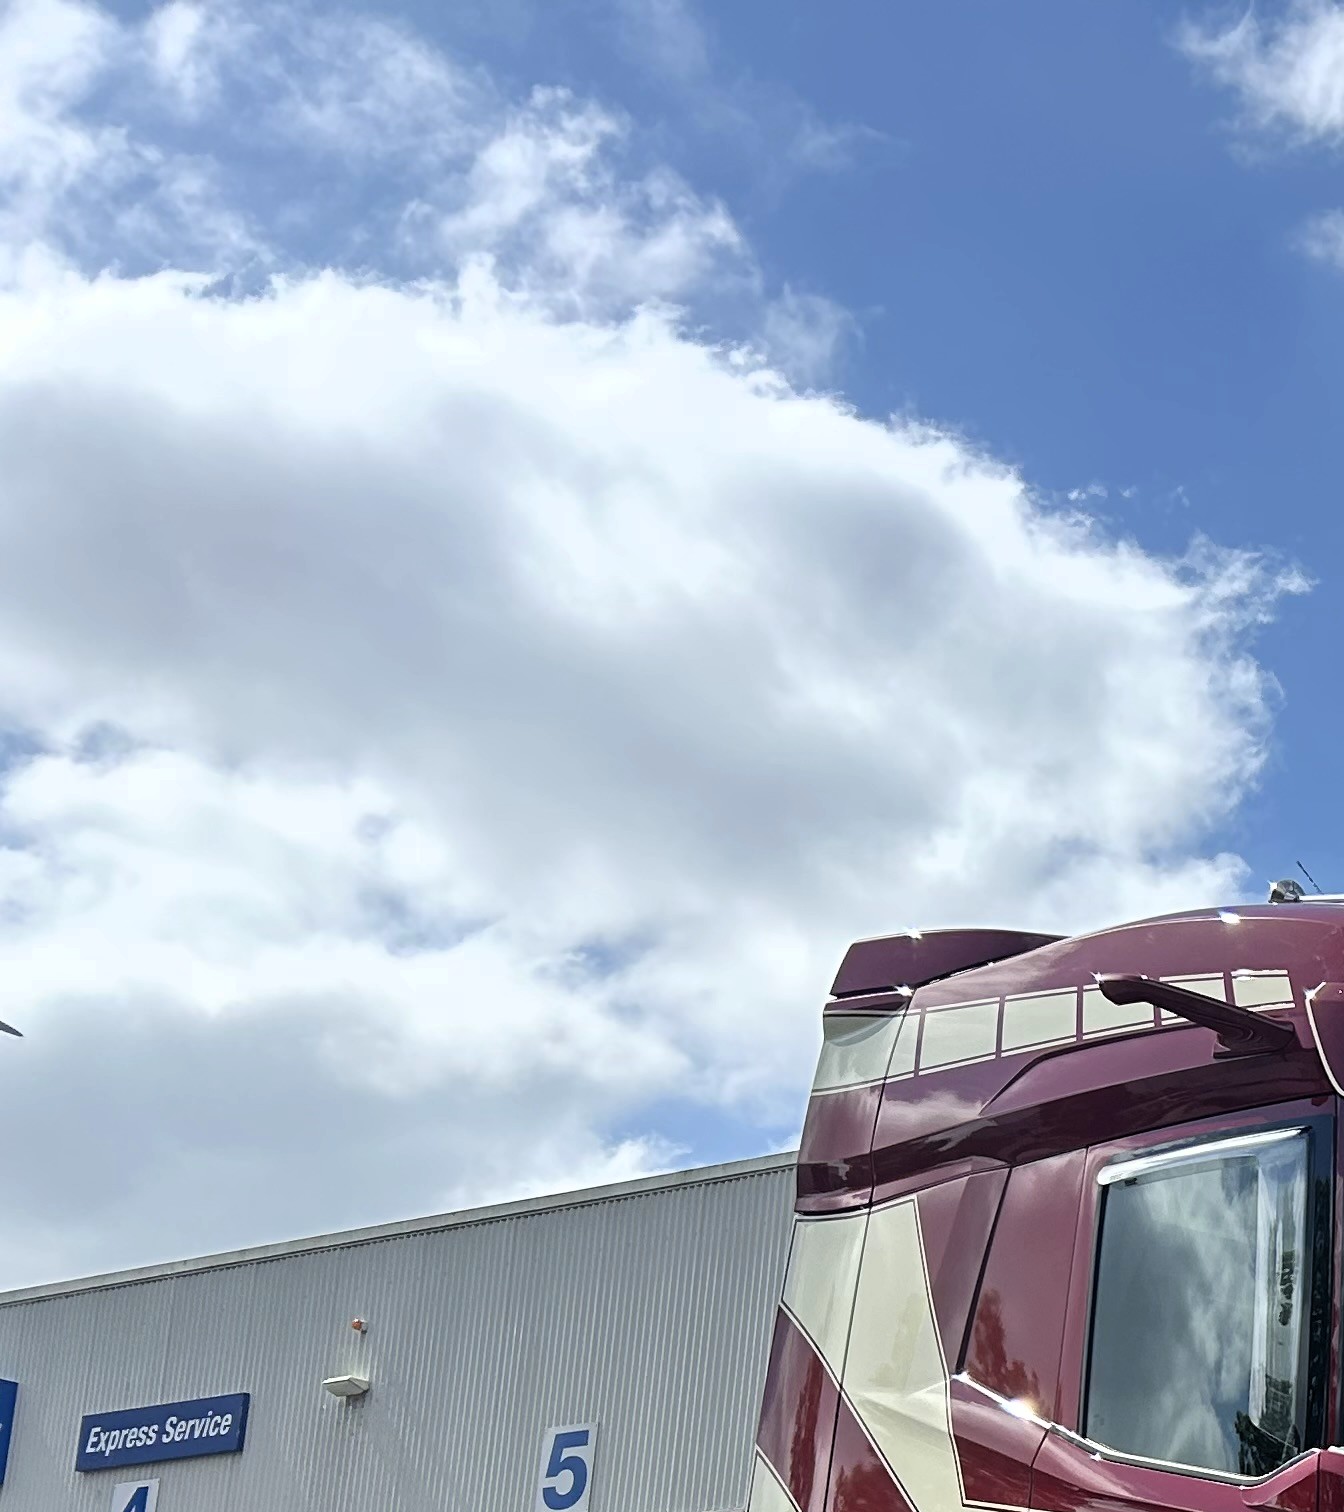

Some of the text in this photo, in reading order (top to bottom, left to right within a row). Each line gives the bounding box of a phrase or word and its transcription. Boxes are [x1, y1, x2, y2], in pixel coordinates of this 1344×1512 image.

[85, 1410, 233, 1457] Express Service
[542, 1429, 590, 1511] 5
